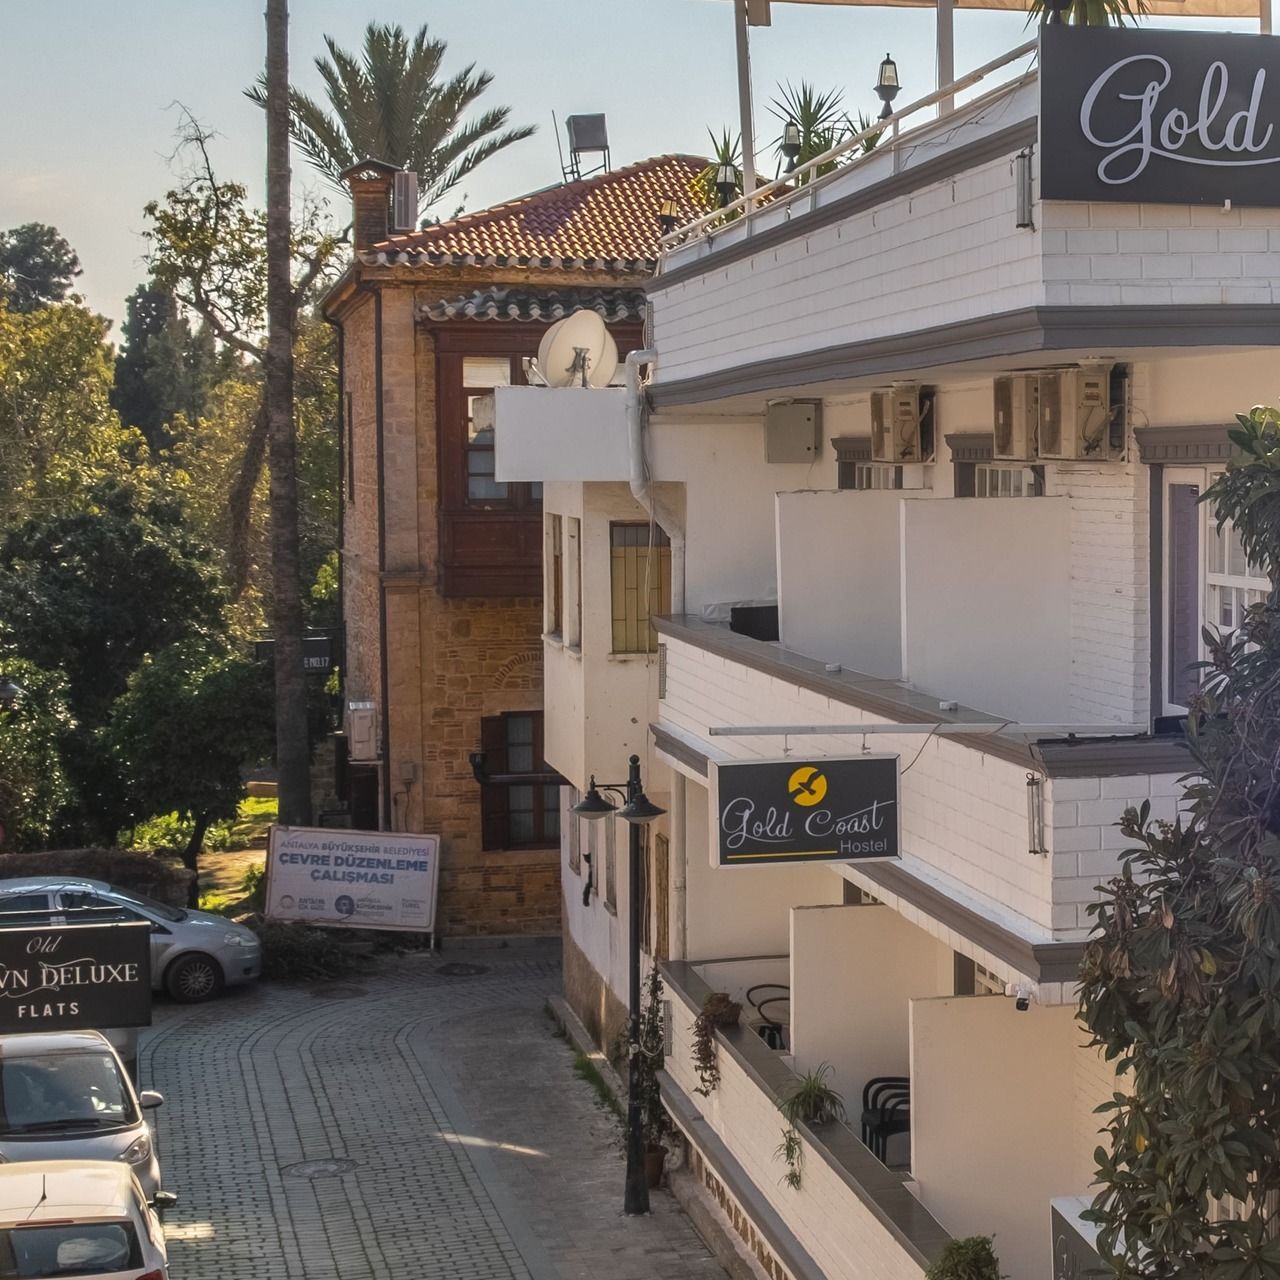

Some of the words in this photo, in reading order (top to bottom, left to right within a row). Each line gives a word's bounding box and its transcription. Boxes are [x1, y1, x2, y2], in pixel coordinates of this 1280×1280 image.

[722, 797, 796, 849] Gold
[804, 799, 895, 837] Coast
[280, 841, 320, 850] ANTALYA
[840, 838, 888, 854] Hostel
[279, 852, 331, 866] ÇEVRE
[334, 854, 429, 873] DÜZENLEME
[310, 869, 395, 885] ÇALIŞMASI
[26, 936, 62, 954] Old
[38, 959, 139, 990] DELUXE
[18, 1002, 79, 1018] FLATS
